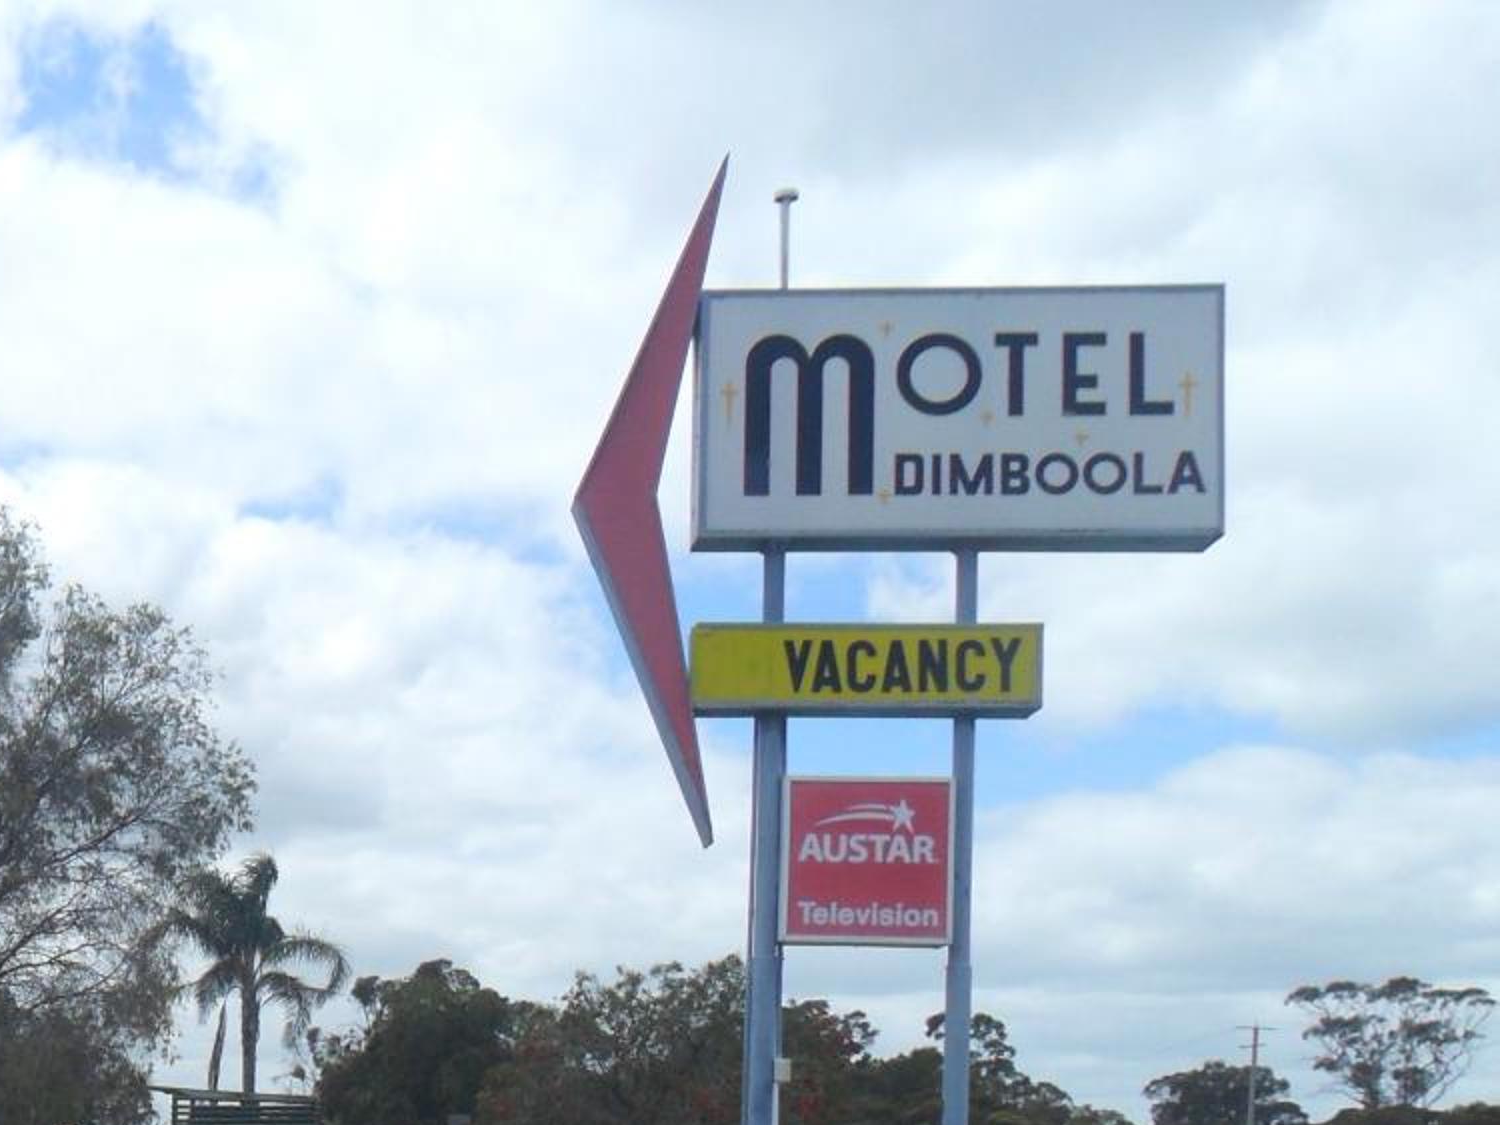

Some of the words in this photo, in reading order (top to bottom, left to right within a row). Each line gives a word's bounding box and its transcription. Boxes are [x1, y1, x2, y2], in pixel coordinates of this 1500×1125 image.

[743, 332, 1174, 496] MOTEL
[894, 451, 1206, 495] DIMBOOLA
[784, 637, 1023, 693] VACANCY
[799, 832, 935, 863] AUSTAR
[798, 901, 939, 928] Television
